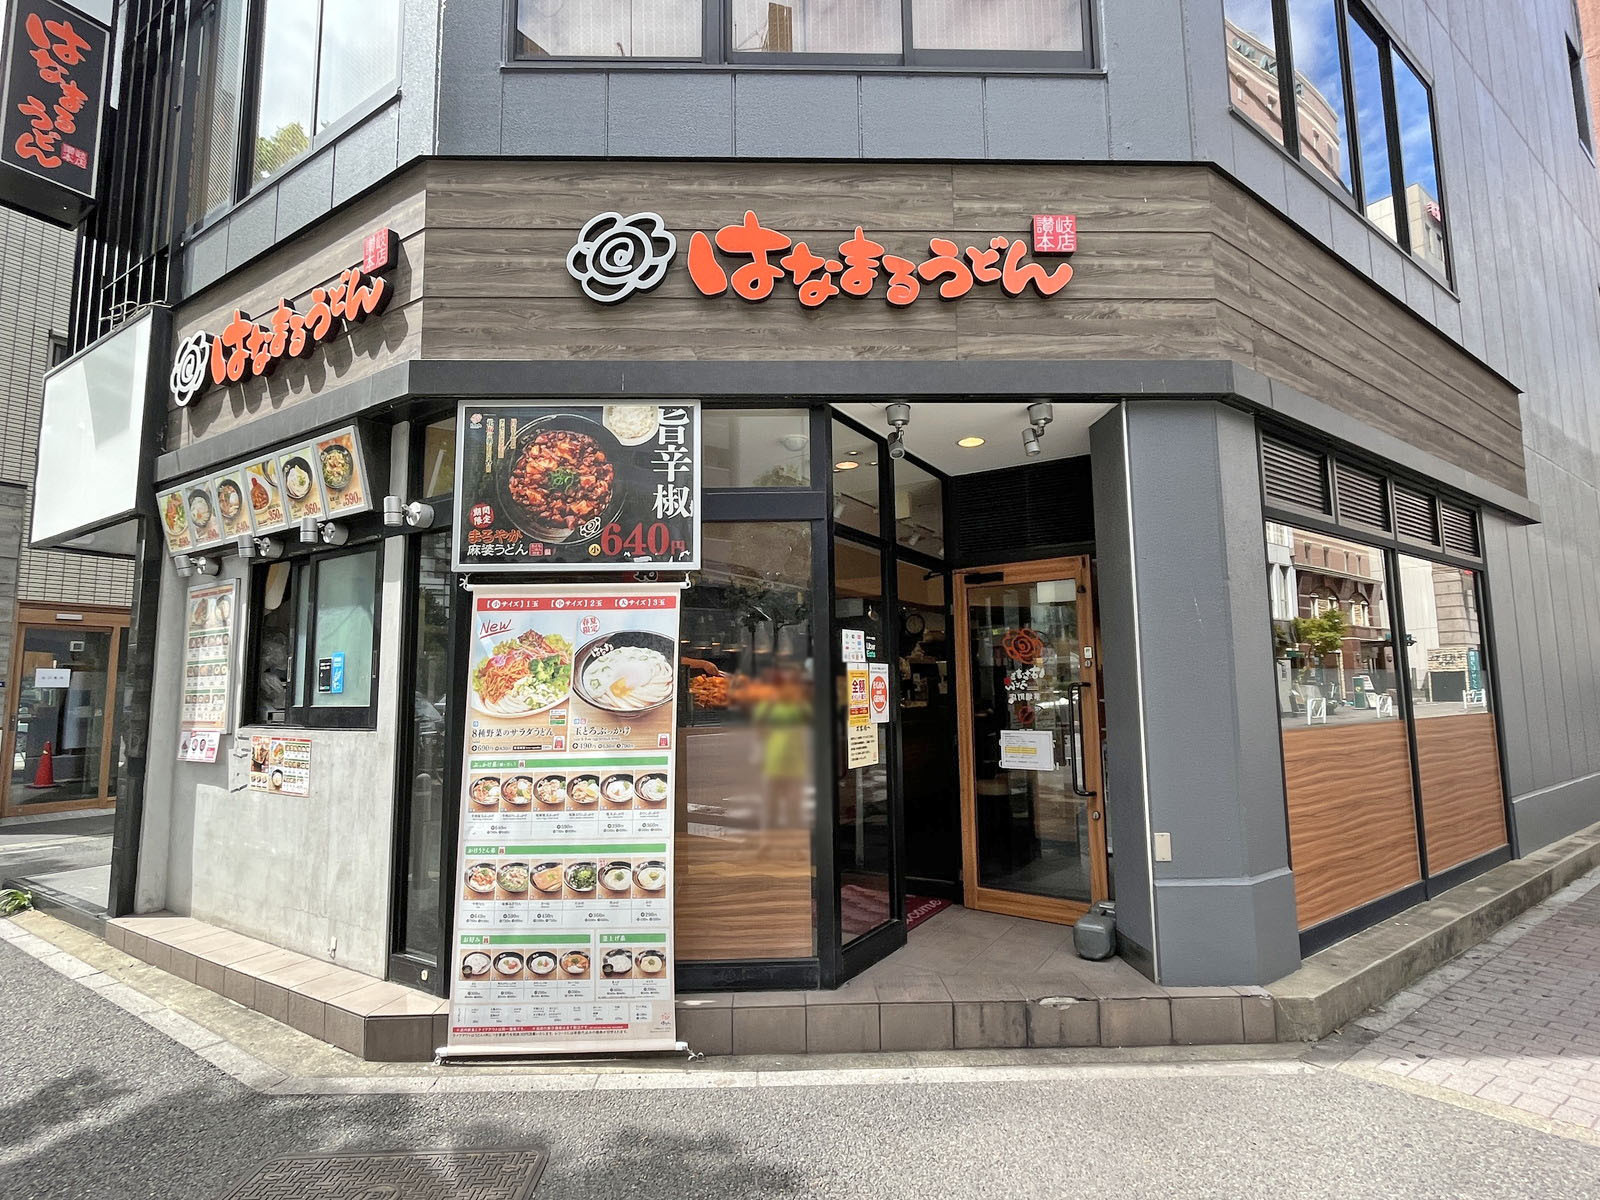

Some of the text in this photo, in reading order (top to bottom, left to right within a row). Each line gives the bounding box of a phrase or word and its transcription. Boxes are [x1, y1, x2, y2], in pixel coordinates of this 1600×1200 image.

[687, 209, 1076, 308] はなまるうどん
[211, 267, 387, 385] はなまるうどん
[467, 529, 523, 544] まろやか
[467, 542, 528, 556] 麻婆うどん
[480, 619, 512, 635] New
[471, 727, 554, 738] 8種野菜のサラダうどん
